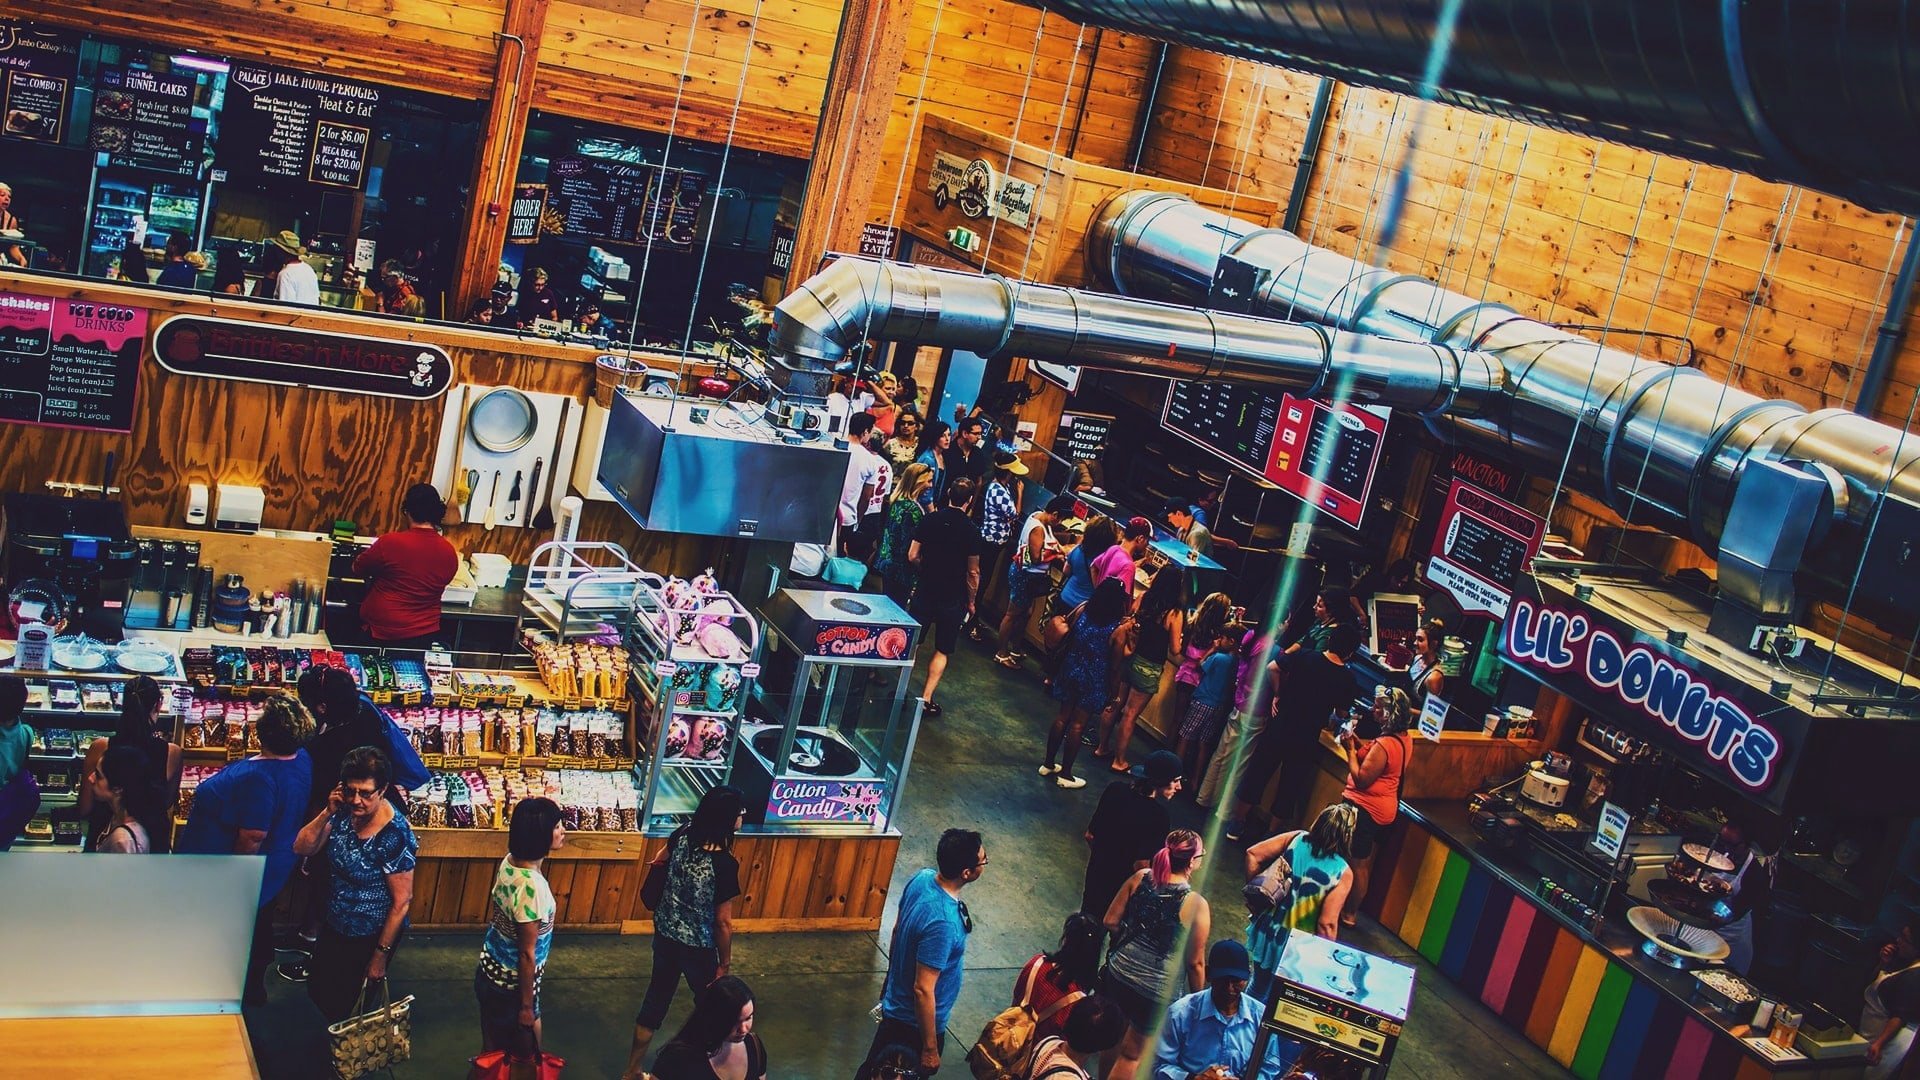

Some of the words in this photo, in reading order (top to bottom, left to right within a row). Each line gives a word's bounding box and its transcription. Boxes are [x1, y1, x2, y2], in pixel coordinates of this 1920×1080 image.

[128, 70, 140, 78] Fresh
[239, 71, 267, 85] PALACE
[29, 79, 56, 91] COMBO
[57, 82, 62, 92] 3
[126, 77, 158, 92] FUNNEL
[160, 83, 187, 97] CAKES
[137, 99, 152, 109] Fresh
[345, 101, 355, 114] &
[42, 117, 57, 135] $7
[320, 127, 326, 137] 2
[327, 127, 339, 140] for
[340, 130, 365, 144] $6.00
[322, 146, 339, 156] MEGA
[341, 148, 357, 159] DEAL
[314, 154, 320, 165] 8
[321, 155, 332, 166] for
[334, 158, 361, 171] $20.00
[937, 159, 963, 176] Showroom
[932, 169, 946, 180] OPEN
[947, 175, 950, 184] 7
[513, 199, 541, 216] ORDER
[512, 218, 535, 236] HERE
[861, 234, 892, 246] Elevator
[863, 243, 869, 252] $
[69, 304, 94, 318] ICE
[98, 307, 135, 322] COLD
[75, 318, 125, 333] DRINKS
[15, 336, 39, 346] Large
[53, 345, 74, 354] Small
[76, 347, 98, 356] Water
[209, 328, 307, 363] Brittles
[338, 343, 408, 375] More
[51, 355, 73, 363] Large
[75, 357, 97, 365] Water
[50, 364, 64, 373] Pop
[66, 367, 85, 375] (can)
[49, 374, 64, 382] Iced
[67, 376, 79, 384] Tea
[82, 377, 101, 386] (can)
[47, 384, 65, 392] Juice
[68, 387, 87, 395] (can)
[79, 412, 111, 421] FLAVOUR
[1340, 414, 1360, 428] DRINKS
[1074, 422, 1106, 433] Please
[1074, 432, 1102, 441] Order
[1068, 440, 1093, 450] Pizza
[1072, 450, 1096, 459] Here
[1452, 452, 1512, 493] JUNCTION
[875, 475, 887, 497] 2
[1447, 518, 1459, 546] DRINKS
[1447, 580, 1465, 595] PLEASE
[1465, 588, 1481, 602] ORDER
[1480, 596, 1492, 609] HERE
[816, 625, 870, 644] COTTON
[831, 636, 877, 655] CANDY
[1509, 600, 1588, 669] LIL'
[1586, 630, 1779, 787] DONUTS
[772, 783, 827, 800] Cotton
[840, 785, 862, 798] $4
[777, 799, 836, 819] Candy
[843, 803, 850, 811] 2
[853, 803, 876, 816] $6
